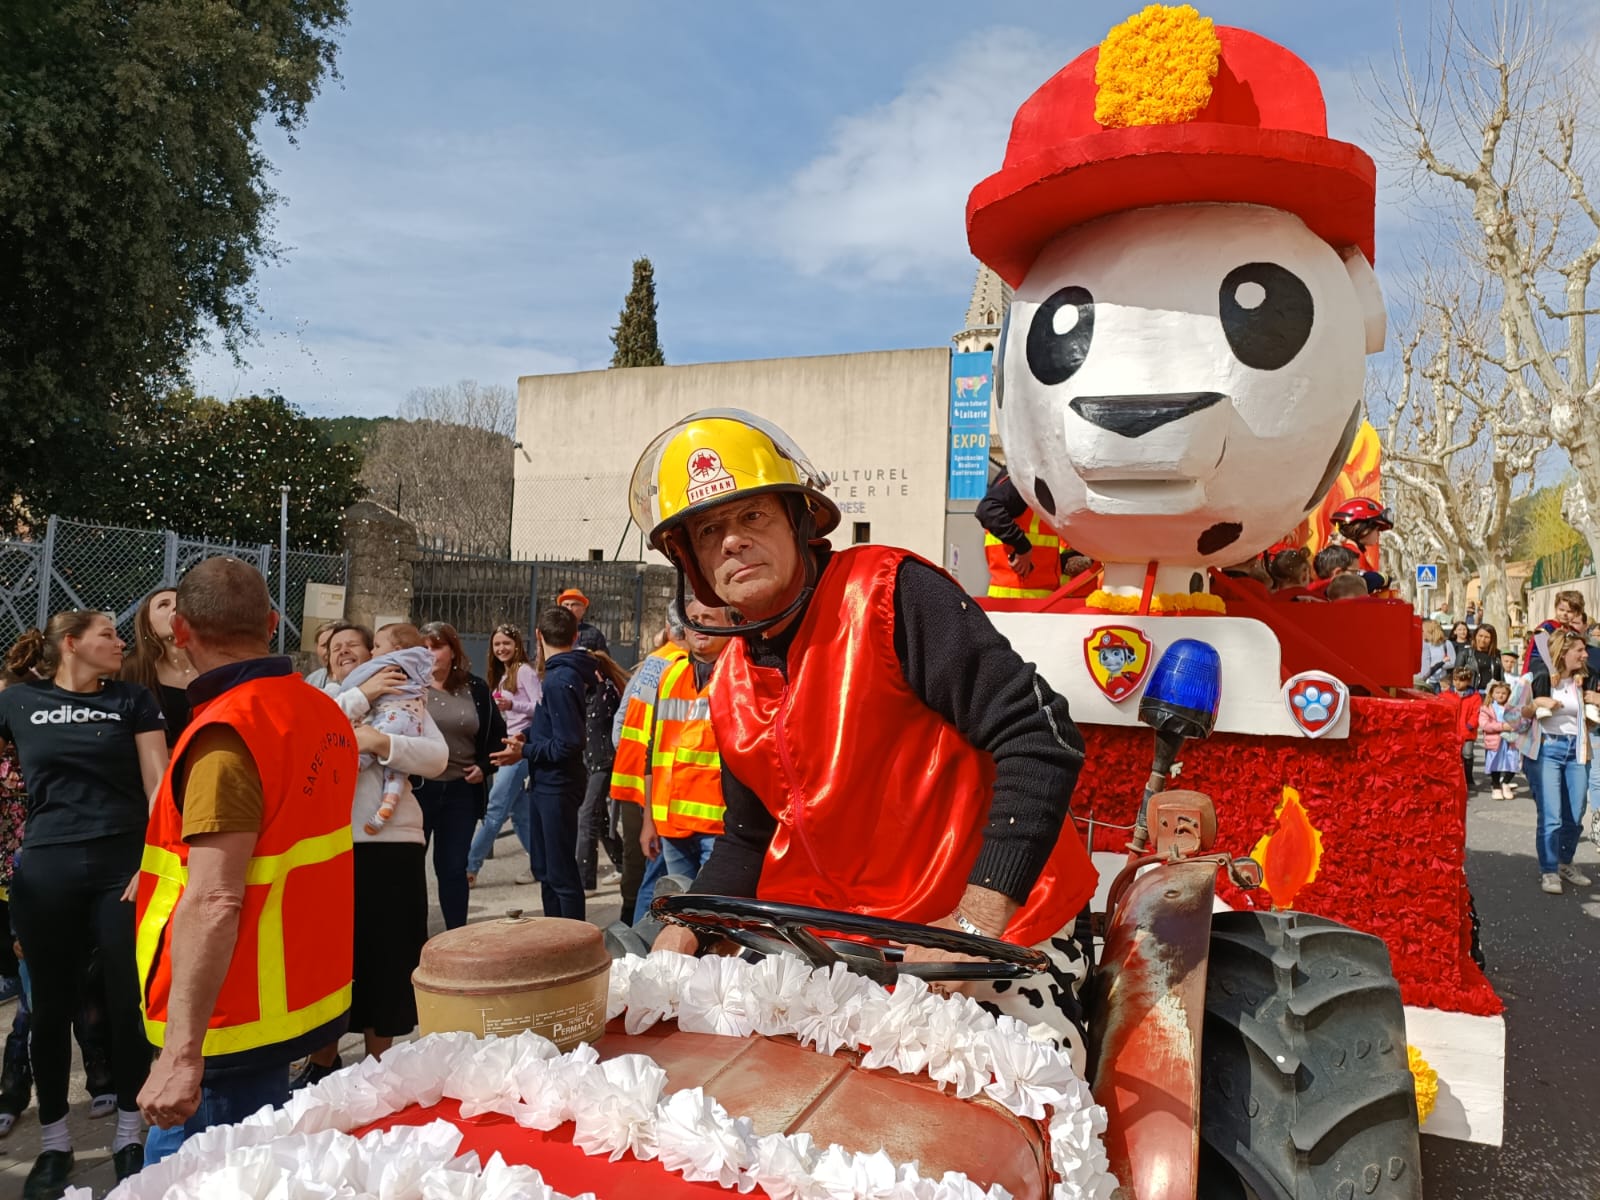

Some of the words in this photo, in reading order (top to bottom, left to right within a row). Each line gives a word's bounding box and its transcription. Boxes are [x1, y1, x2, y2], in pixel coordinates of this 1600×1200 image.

[953, 434, 986, 449] EXPO
[830, 468, 909, 482] ULTUREL
[690, 480, 732, 501] FIREMAN
[833, 484, 909, 498] TERIE
[30, 705, 121, 725] adidas
